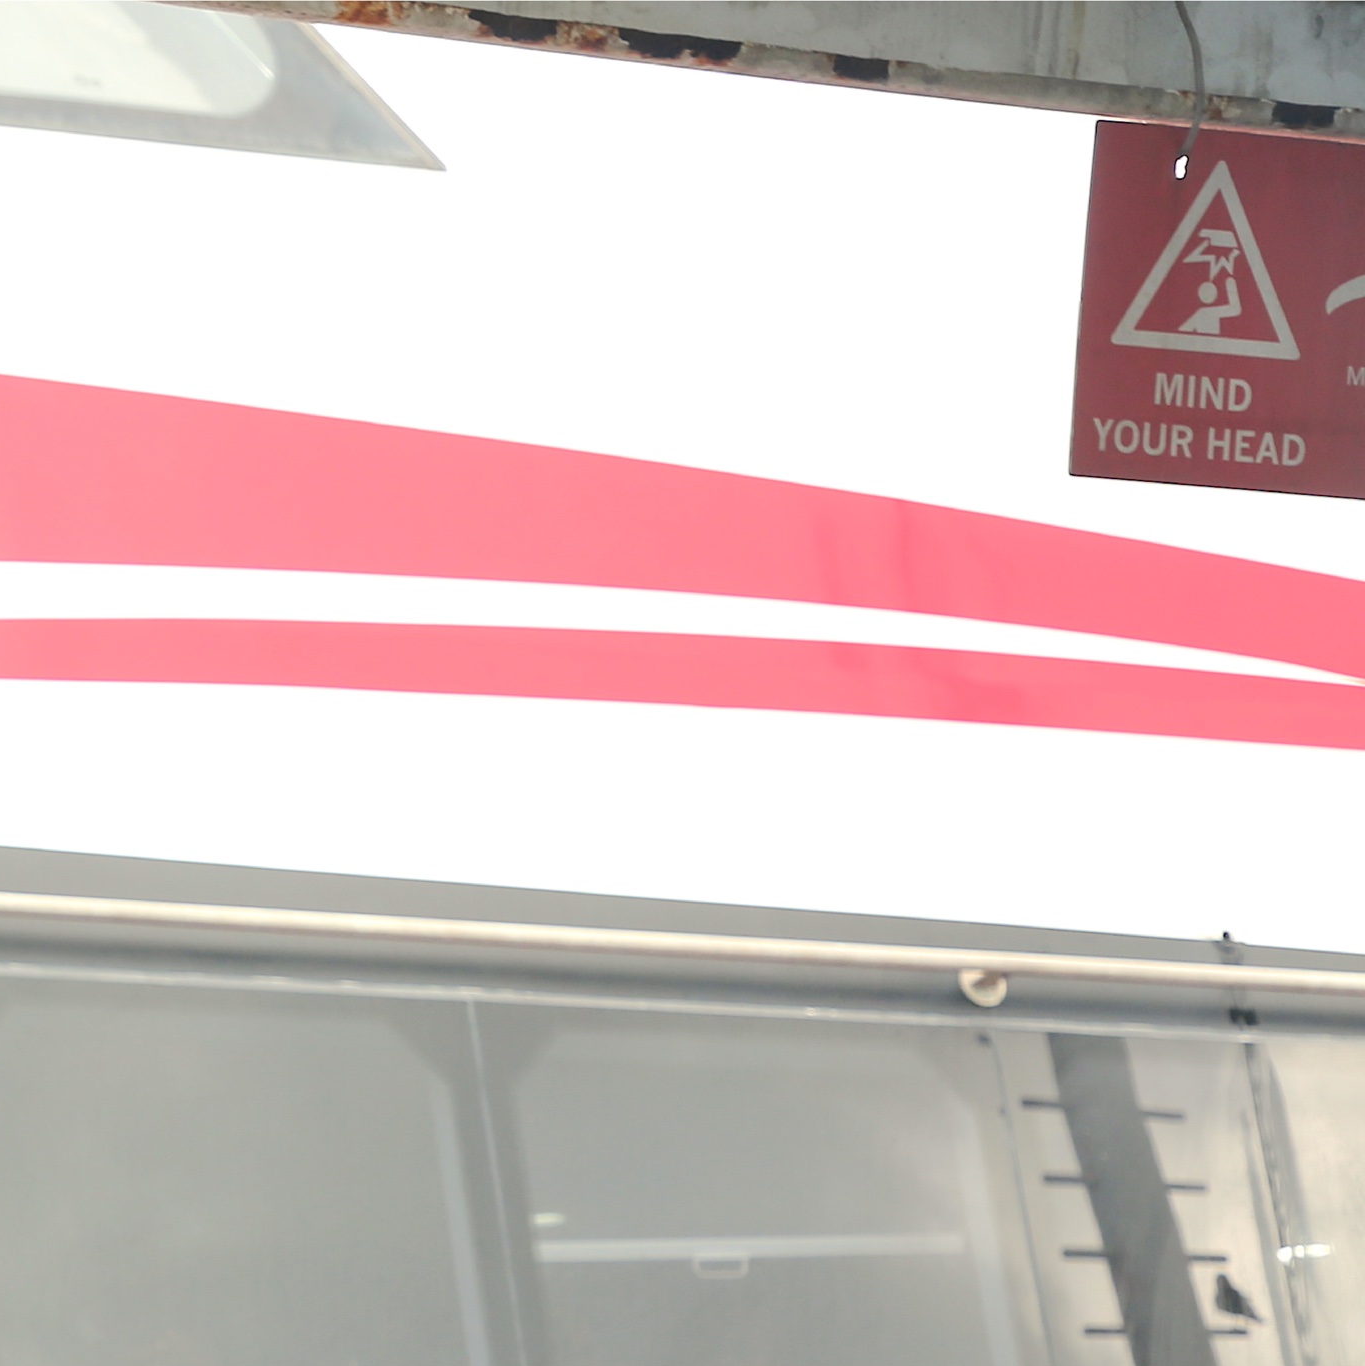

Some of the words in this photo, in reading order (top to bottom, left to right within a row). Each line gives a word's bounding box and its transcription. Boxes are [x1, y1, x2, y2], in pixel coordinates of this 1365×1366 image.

[1153, 372, 1253, 412] MIND
[1092, 417, 1193, 459] YOUR
[1206, 427, 1307, 467] HEAD
